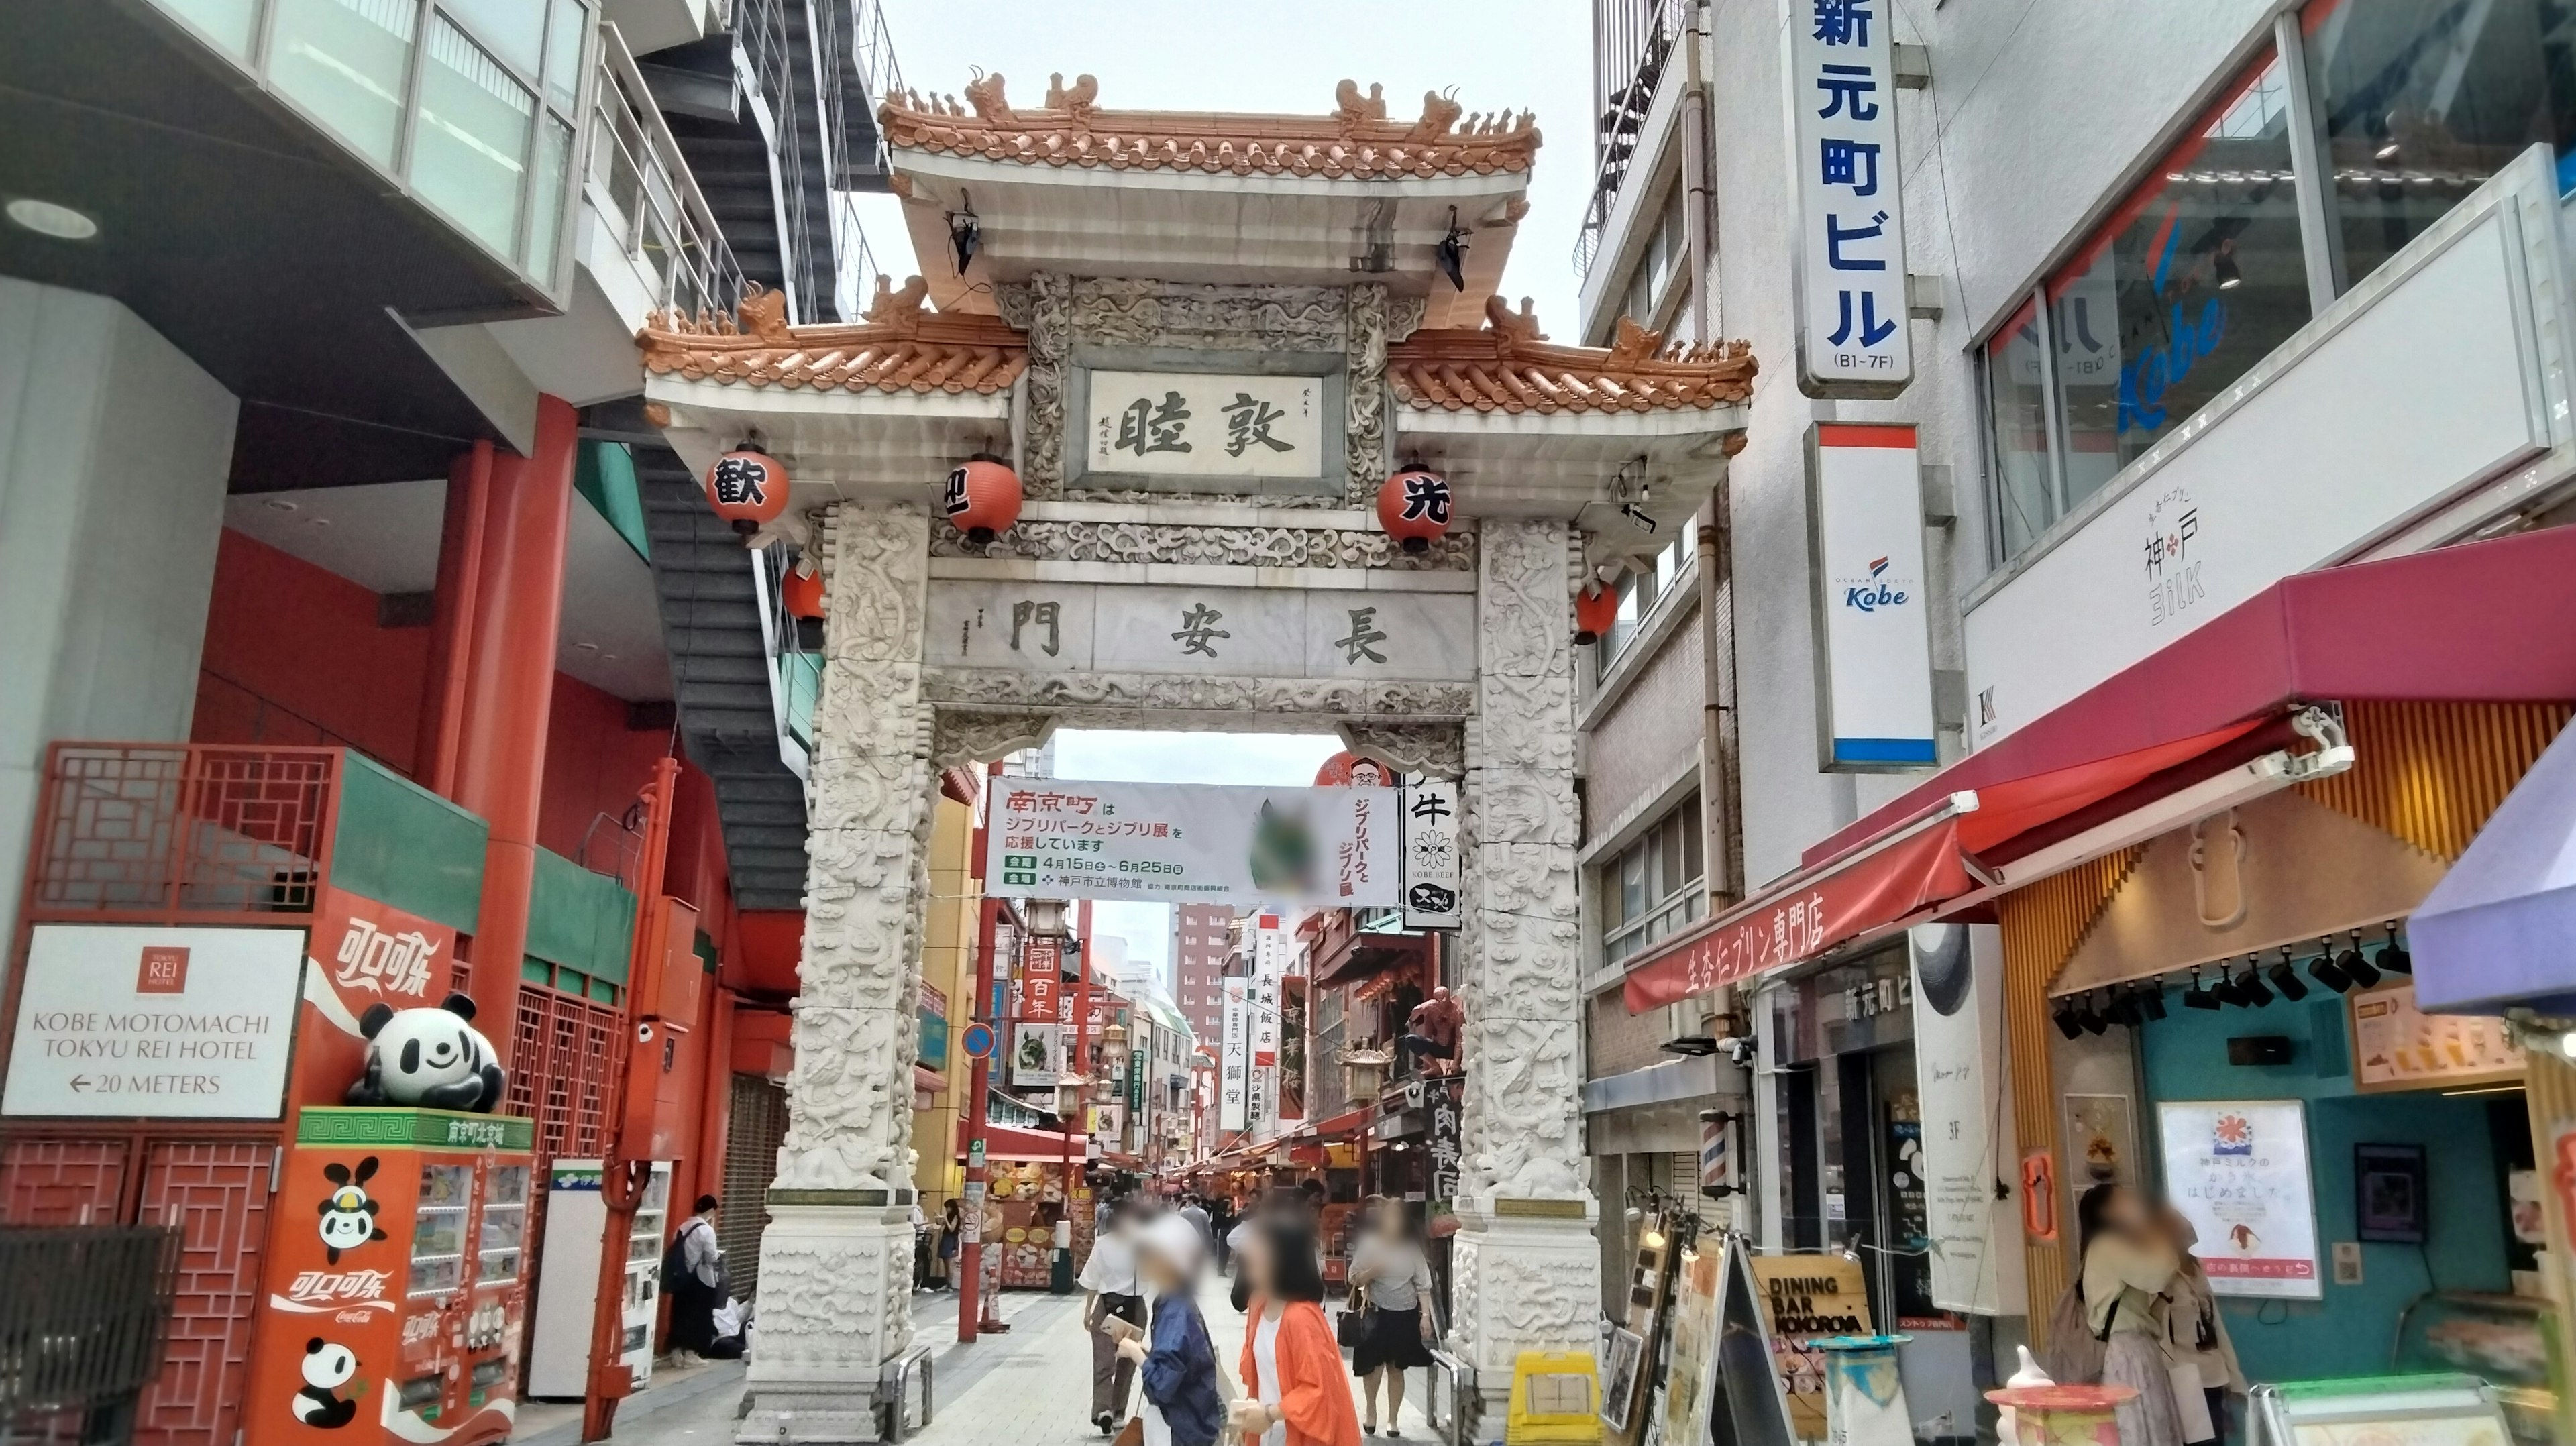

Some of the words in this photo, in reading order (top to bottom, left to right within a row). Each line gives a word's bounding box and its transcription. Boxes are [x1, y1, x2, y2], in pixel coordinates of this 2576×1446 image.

[1812, 0, 1898, 349] 新元町ビル
[2118, 297, 2229, 435] Kobe
[714, 458, 767, 506] 歓
[1399, 475, 1450, 525] 光
[1844, 583, 1909, 612] Kobe
[1006, 817, 1182, 838] ジブリパークとジブリ展を
[1005, 836, 1104, 852] 応援しています
[1355, 799, 1369, 883] ジブリパークと
[1058, 875, 1142, 889] 神戸市立博物館
[1339, 842, 1354, 897] ジブリ展
[1685, 891, 1824, 995] 生杏仁プリン専門店
[150, 962, 177, 978] REI
[1028, 979, 1055, 1018] 百年
[1260, 973, 1273, 1044] 長城飯店
[34, 1013, 98, 1032] KOBE
[105, 1014, 269, 1034] MOTOMACHI
[45, 1039, 128, 1058] TOKYU
[137, 1041, 170, 1058] REI
[179, 1042, 258, 1060] HOTEL
[95, 1075, 121, 1093] 20
[128, 1076, 220, 1094] METERS
[1226, 1042, 1242, 1105] 天獅堂
[1949, 1121, 1960, 1140] 3F
[2200, 1158, 2269, 1166] 神戸ミルクの
[1769, 1277, 1838, 1295] DINING
[1772, 1296, 1814, 1314] BAR
